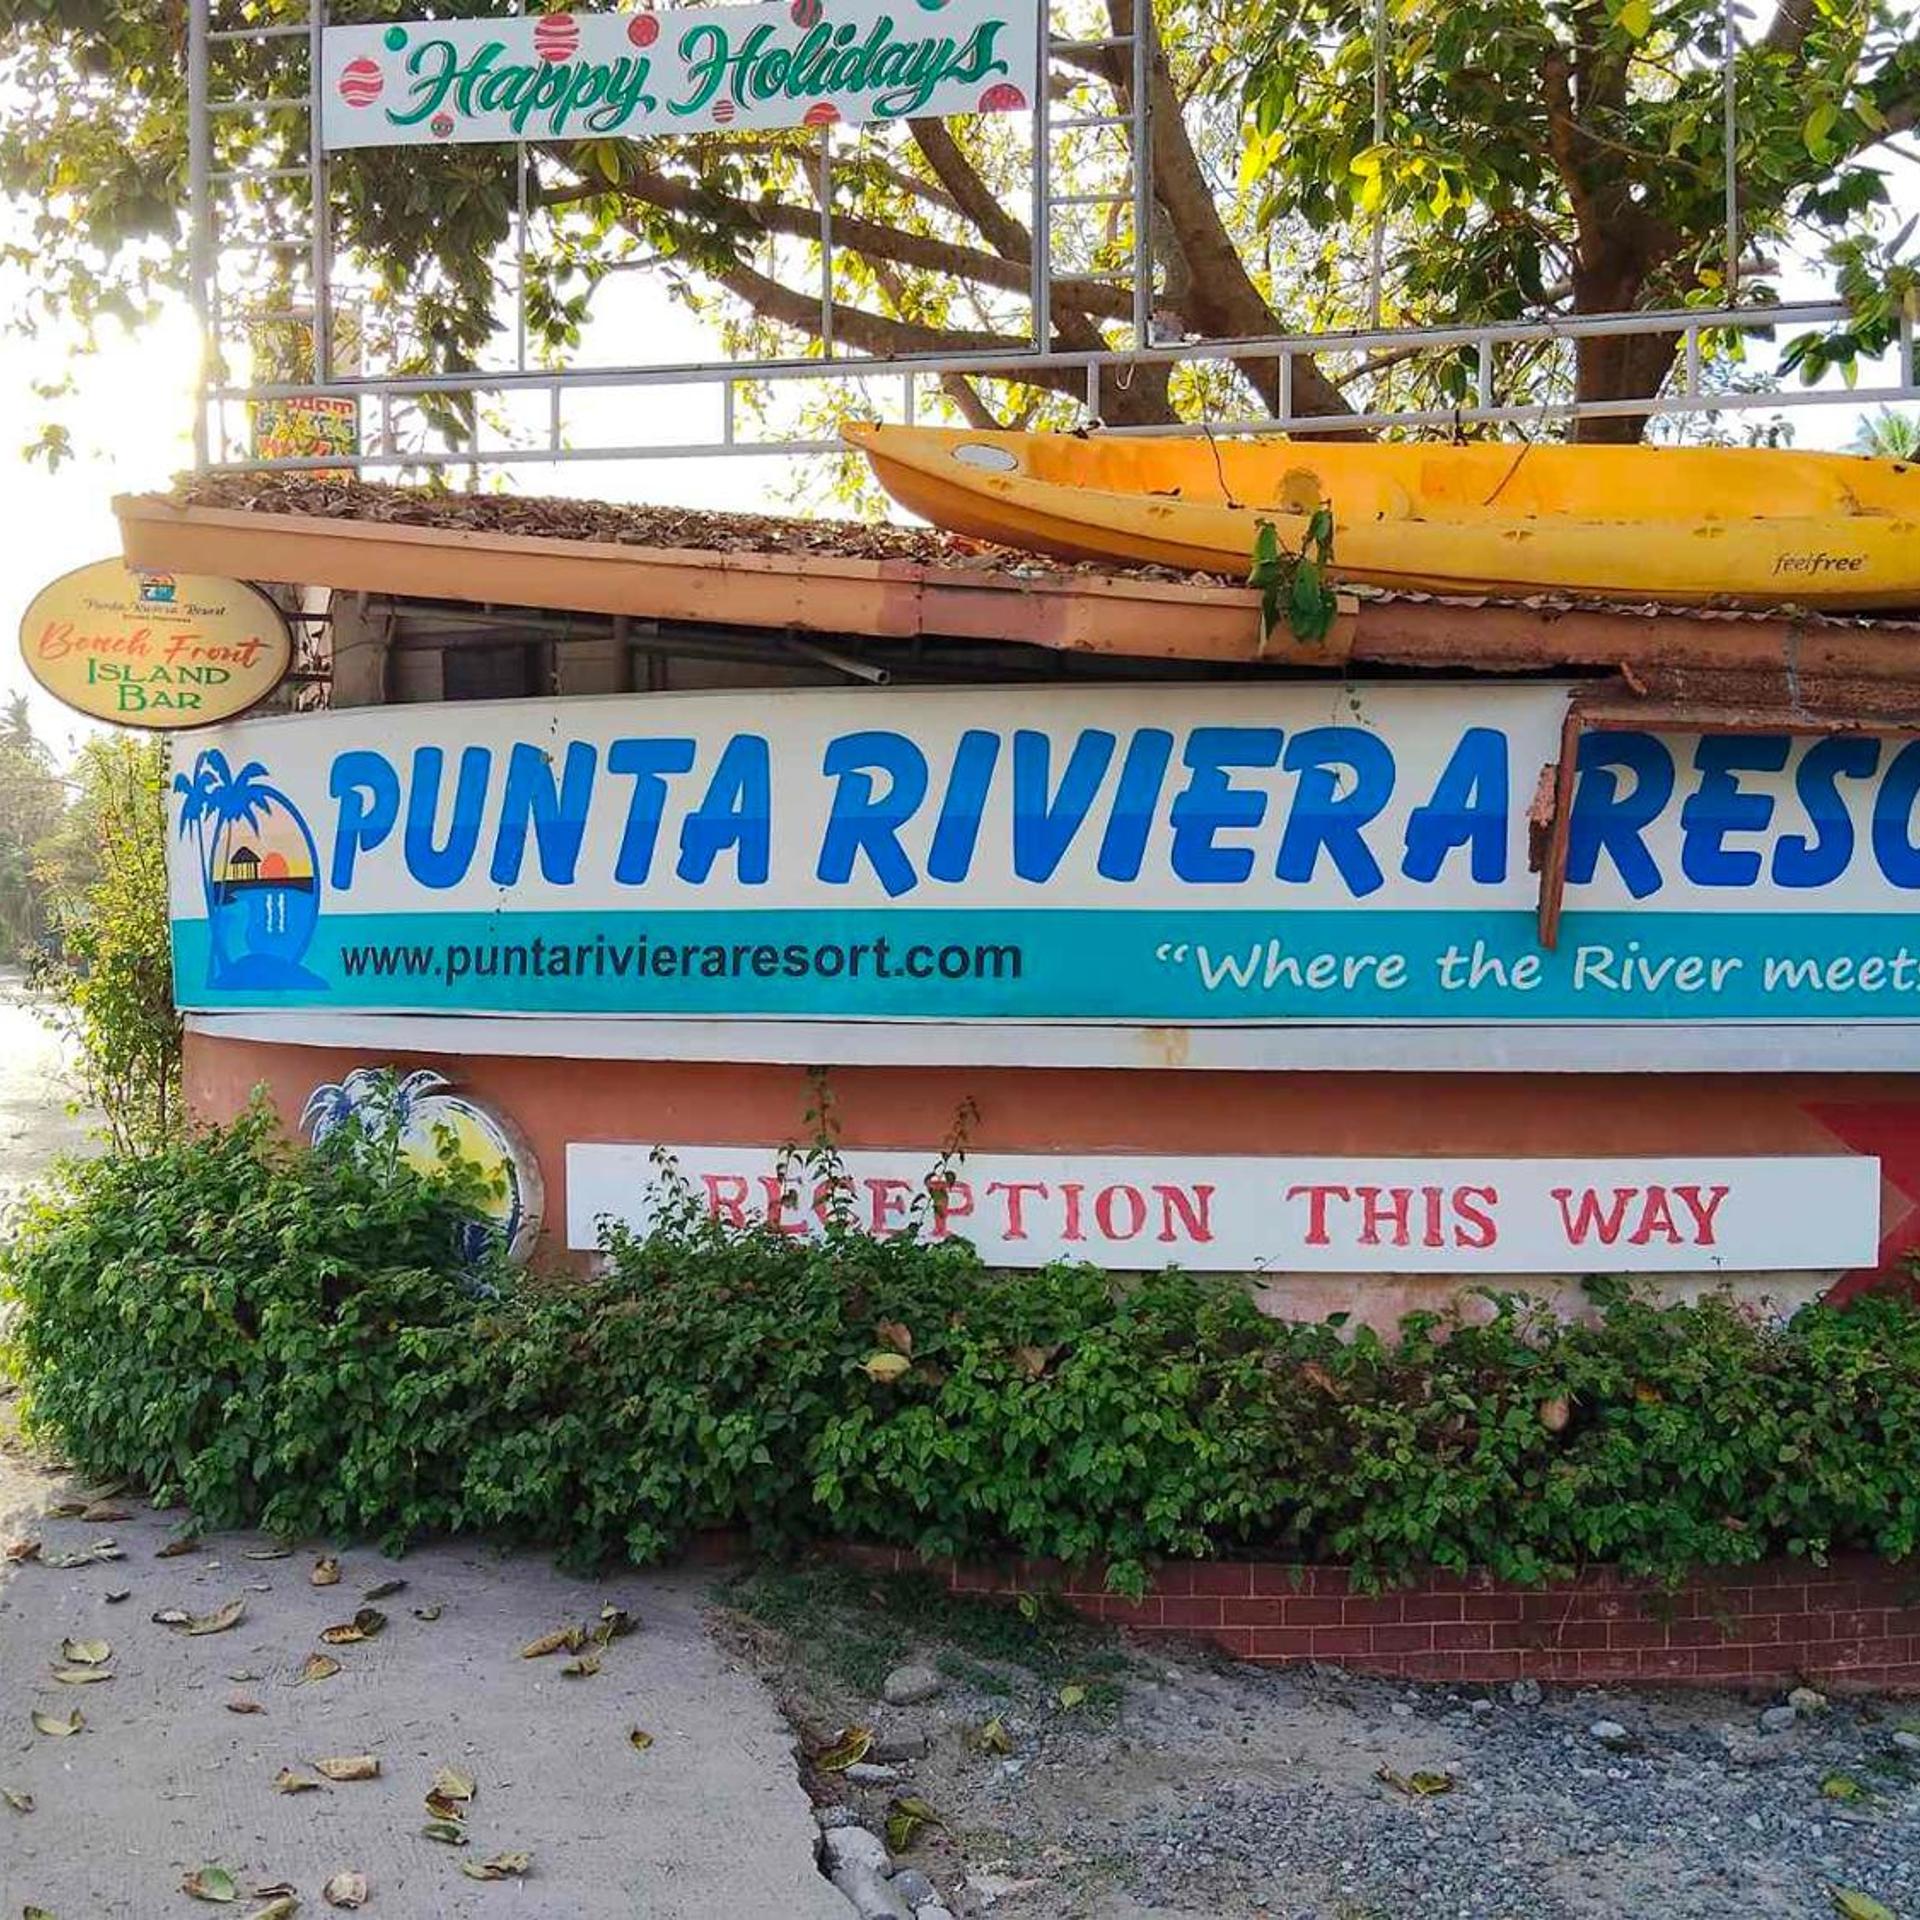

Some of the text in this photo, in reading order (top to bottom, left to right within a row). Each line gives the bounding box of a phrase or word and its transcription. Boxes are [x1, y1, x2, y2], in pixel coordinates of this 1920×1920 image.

[386, 14, 1009, 136] Happy Holidays
[37, 621, 272, 669] Beach Front
[329, 732, 771, 891] PUNTA
[815, 726, 1509, 898] RIVIERA
[341, 933, 1022, 985] www.puntarivieraresort.com
[1155, 937, 1920, 993] “Where the River meet
[1286, 1185, 1499, 1248] THIS
[1549, 1185, 1730, 1246] WAY
